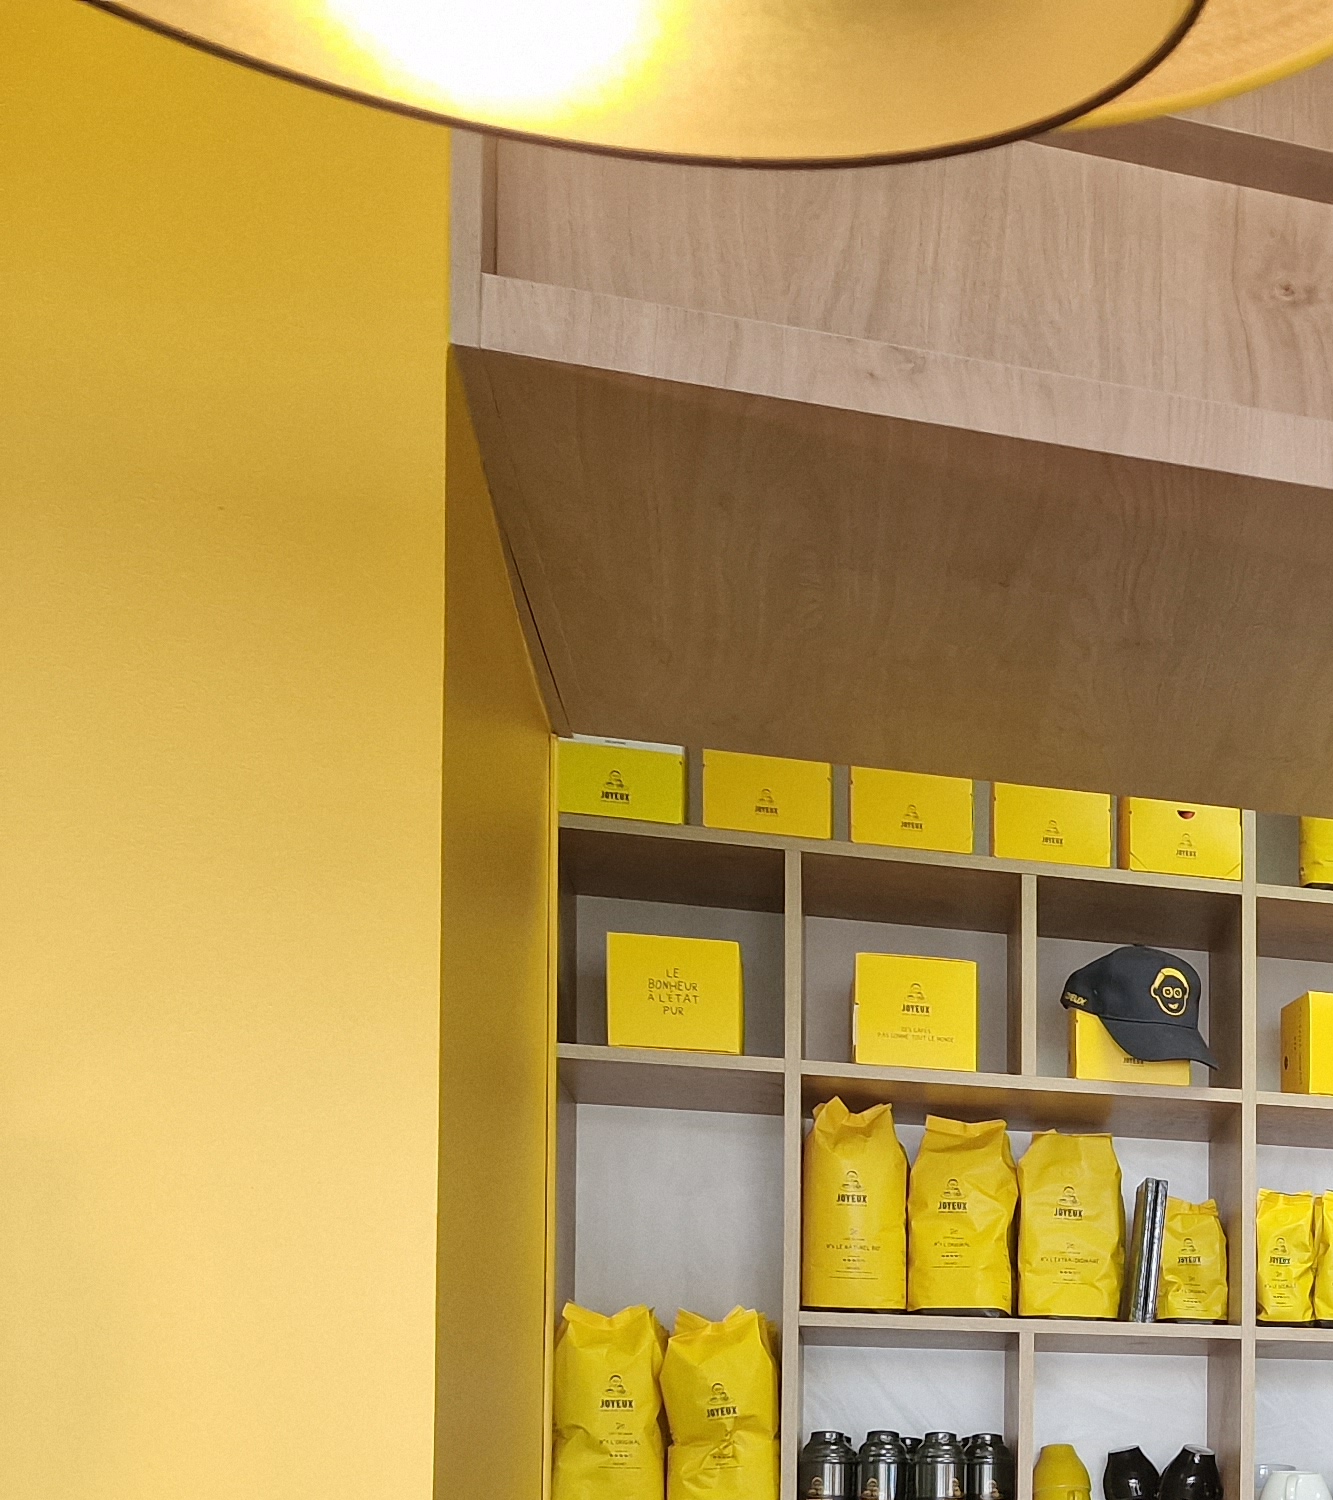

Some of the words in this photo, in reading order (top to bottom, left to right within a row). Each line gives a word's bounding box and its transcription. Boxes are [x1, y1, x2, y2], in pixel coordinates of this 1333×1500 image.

[601, 791, 629, 801] JOYEUX
[666, 968, 679, 980] LE
[648, 978, 698, 993] BONHEUR
[663, 1006, 684, 1016] PUR
[836, 1194, 867, 1203] JOYEUX
[1054, 1208, 1083, 1218] JOYEUX
[600, 1399, 633, 1408] JOYEUX
